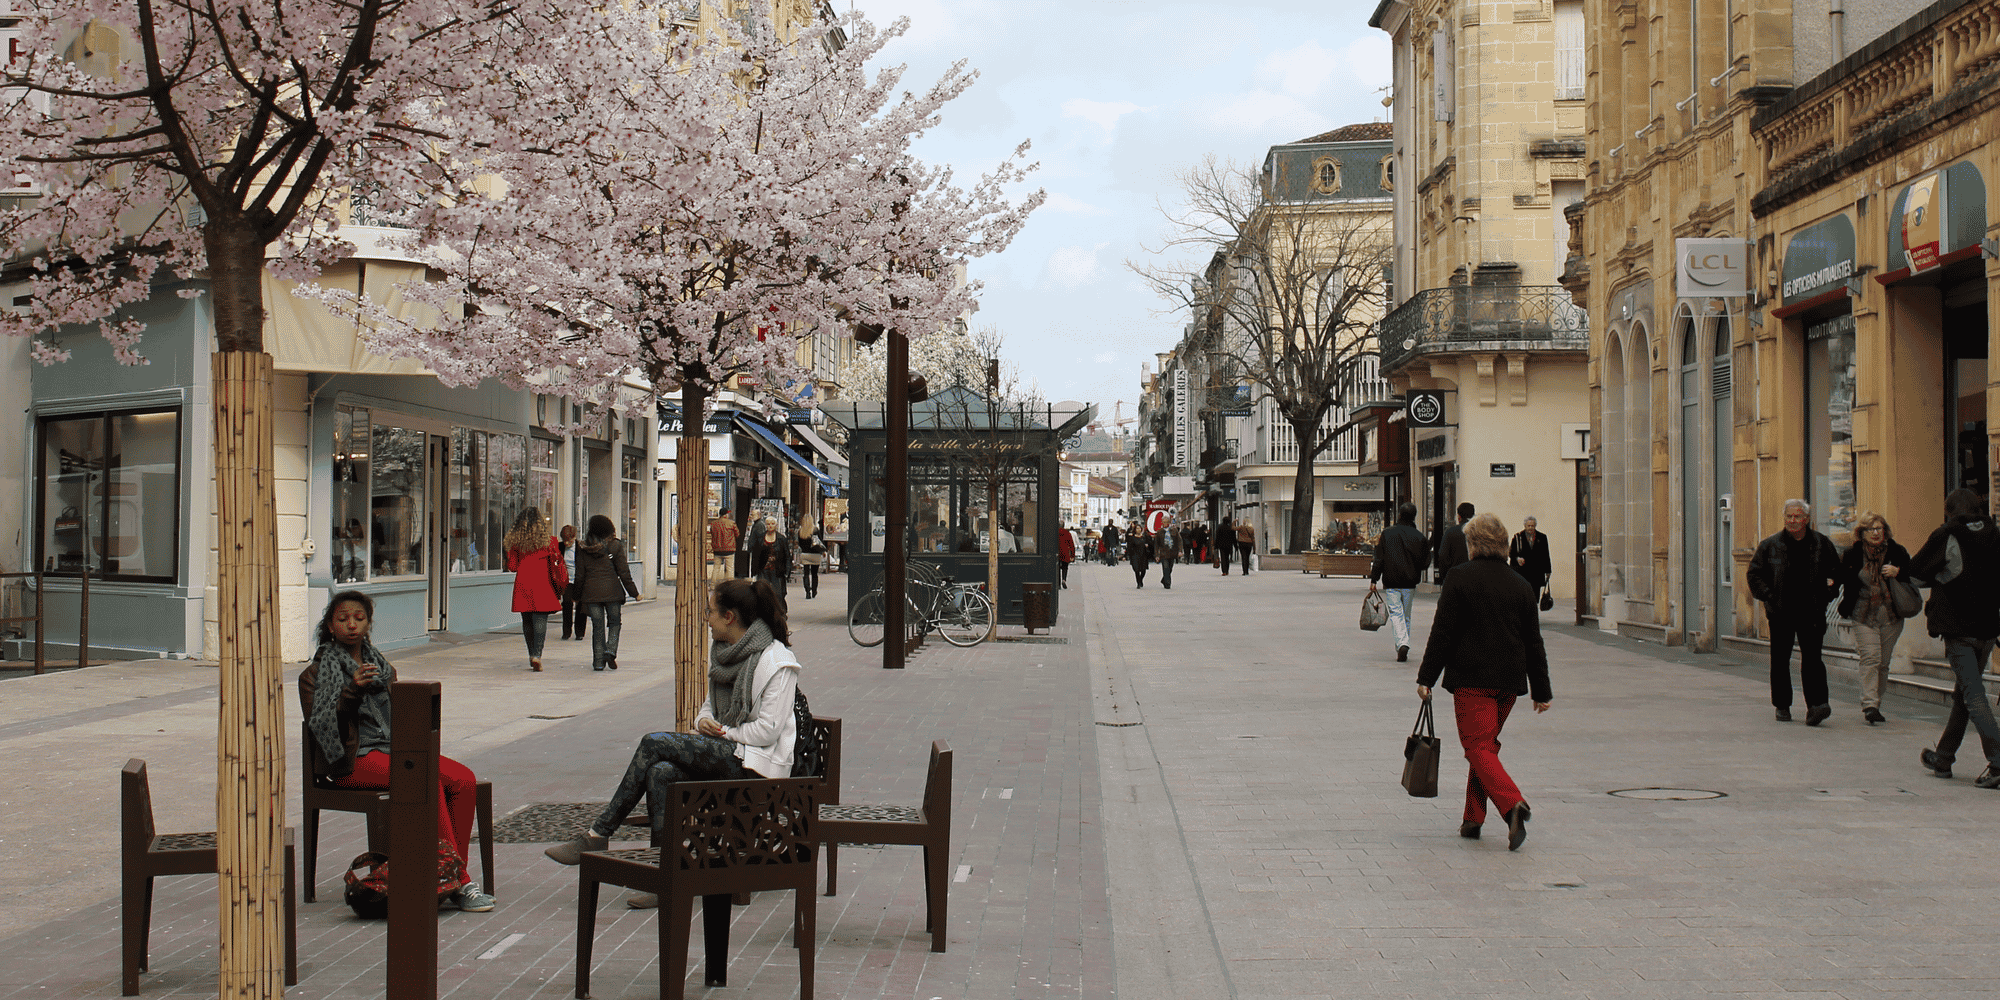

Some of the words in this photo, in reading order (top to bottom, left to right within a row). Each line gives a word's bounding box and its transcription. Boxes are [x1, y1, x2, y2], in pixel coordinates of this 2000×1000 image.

[1690, 254, 1738, 270] LCL
[1783, 280, 1791, 298] LES
[1791, 271, 1817, 296] OPTICIENS
[1816, 259, 1851, 287] MUTUALISTES
[1808, 320, 1838, 340] AUDITION
[1176, 370, 1186, 414] GALERIES
[658, 419, 670, 432] Le
[907, 439, 924, 449] la
[930, 439, 961, 449] ville
[1176, 415, 1186, 466] NOUVELLES
